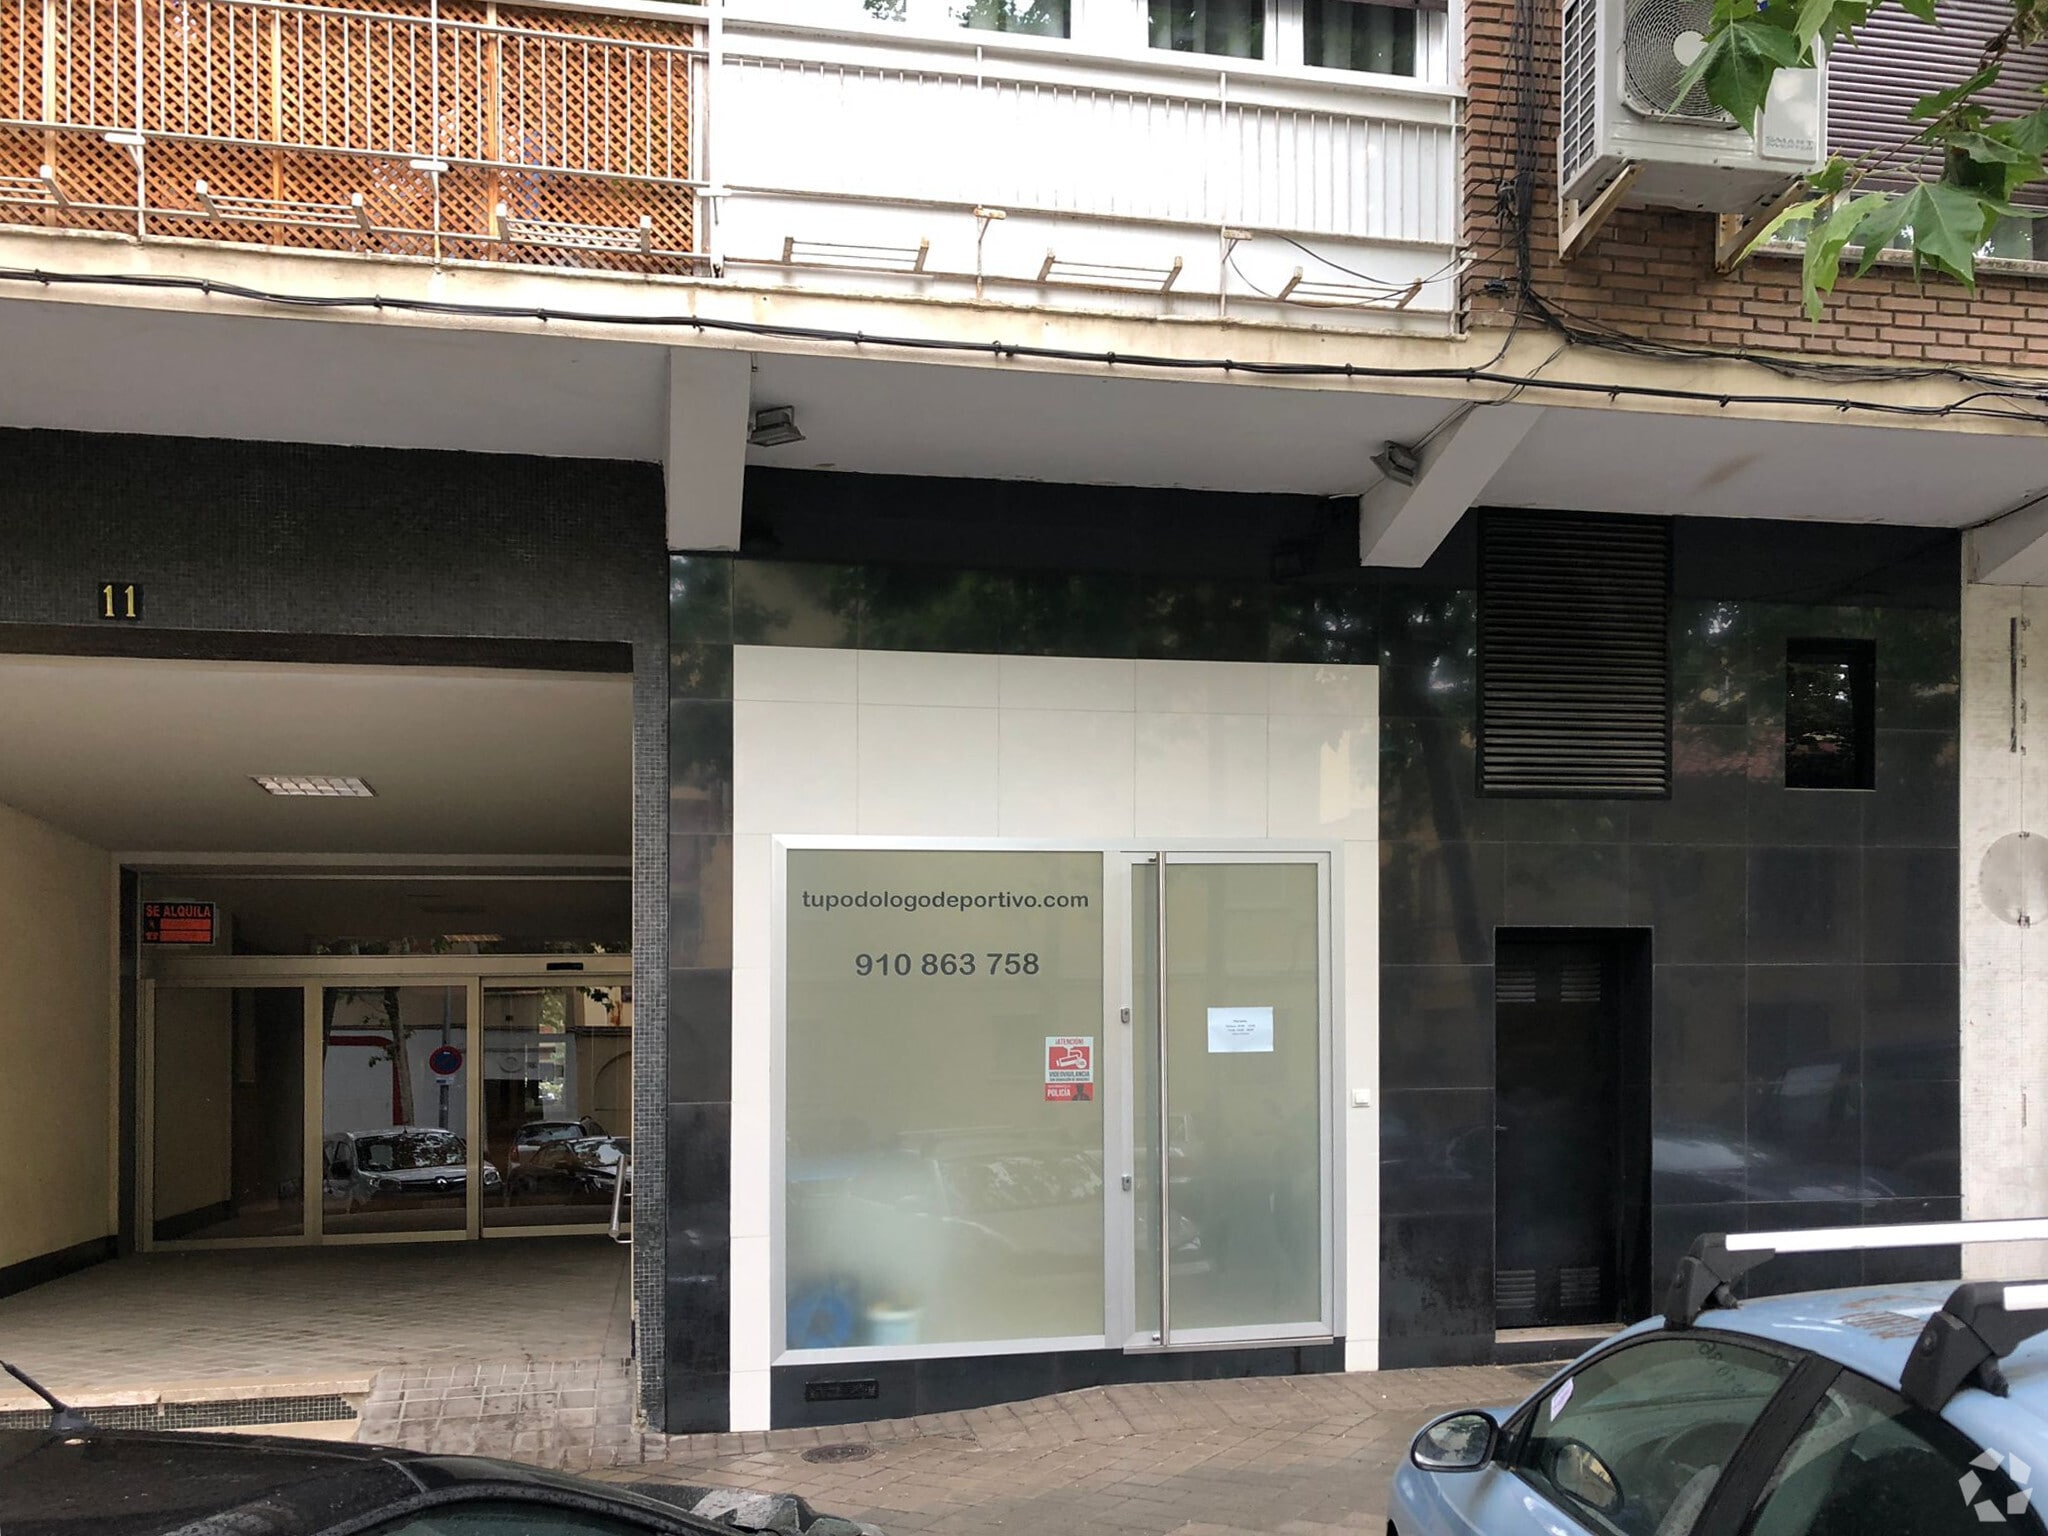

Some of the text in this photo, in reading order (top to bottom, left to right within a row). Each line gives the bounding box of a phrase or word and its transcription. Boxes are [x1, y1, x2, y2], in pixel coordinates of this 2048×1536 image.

[103, 584, 136, 617] 11
[145, 904, 212, 918] SE ALQUILA
[802, 891, 1089, 911] tupodologodeportivo.com
[855, 952, 1039, 976] 910 863 758
[1047, 1087, 1071, 1097] POLICÍA
